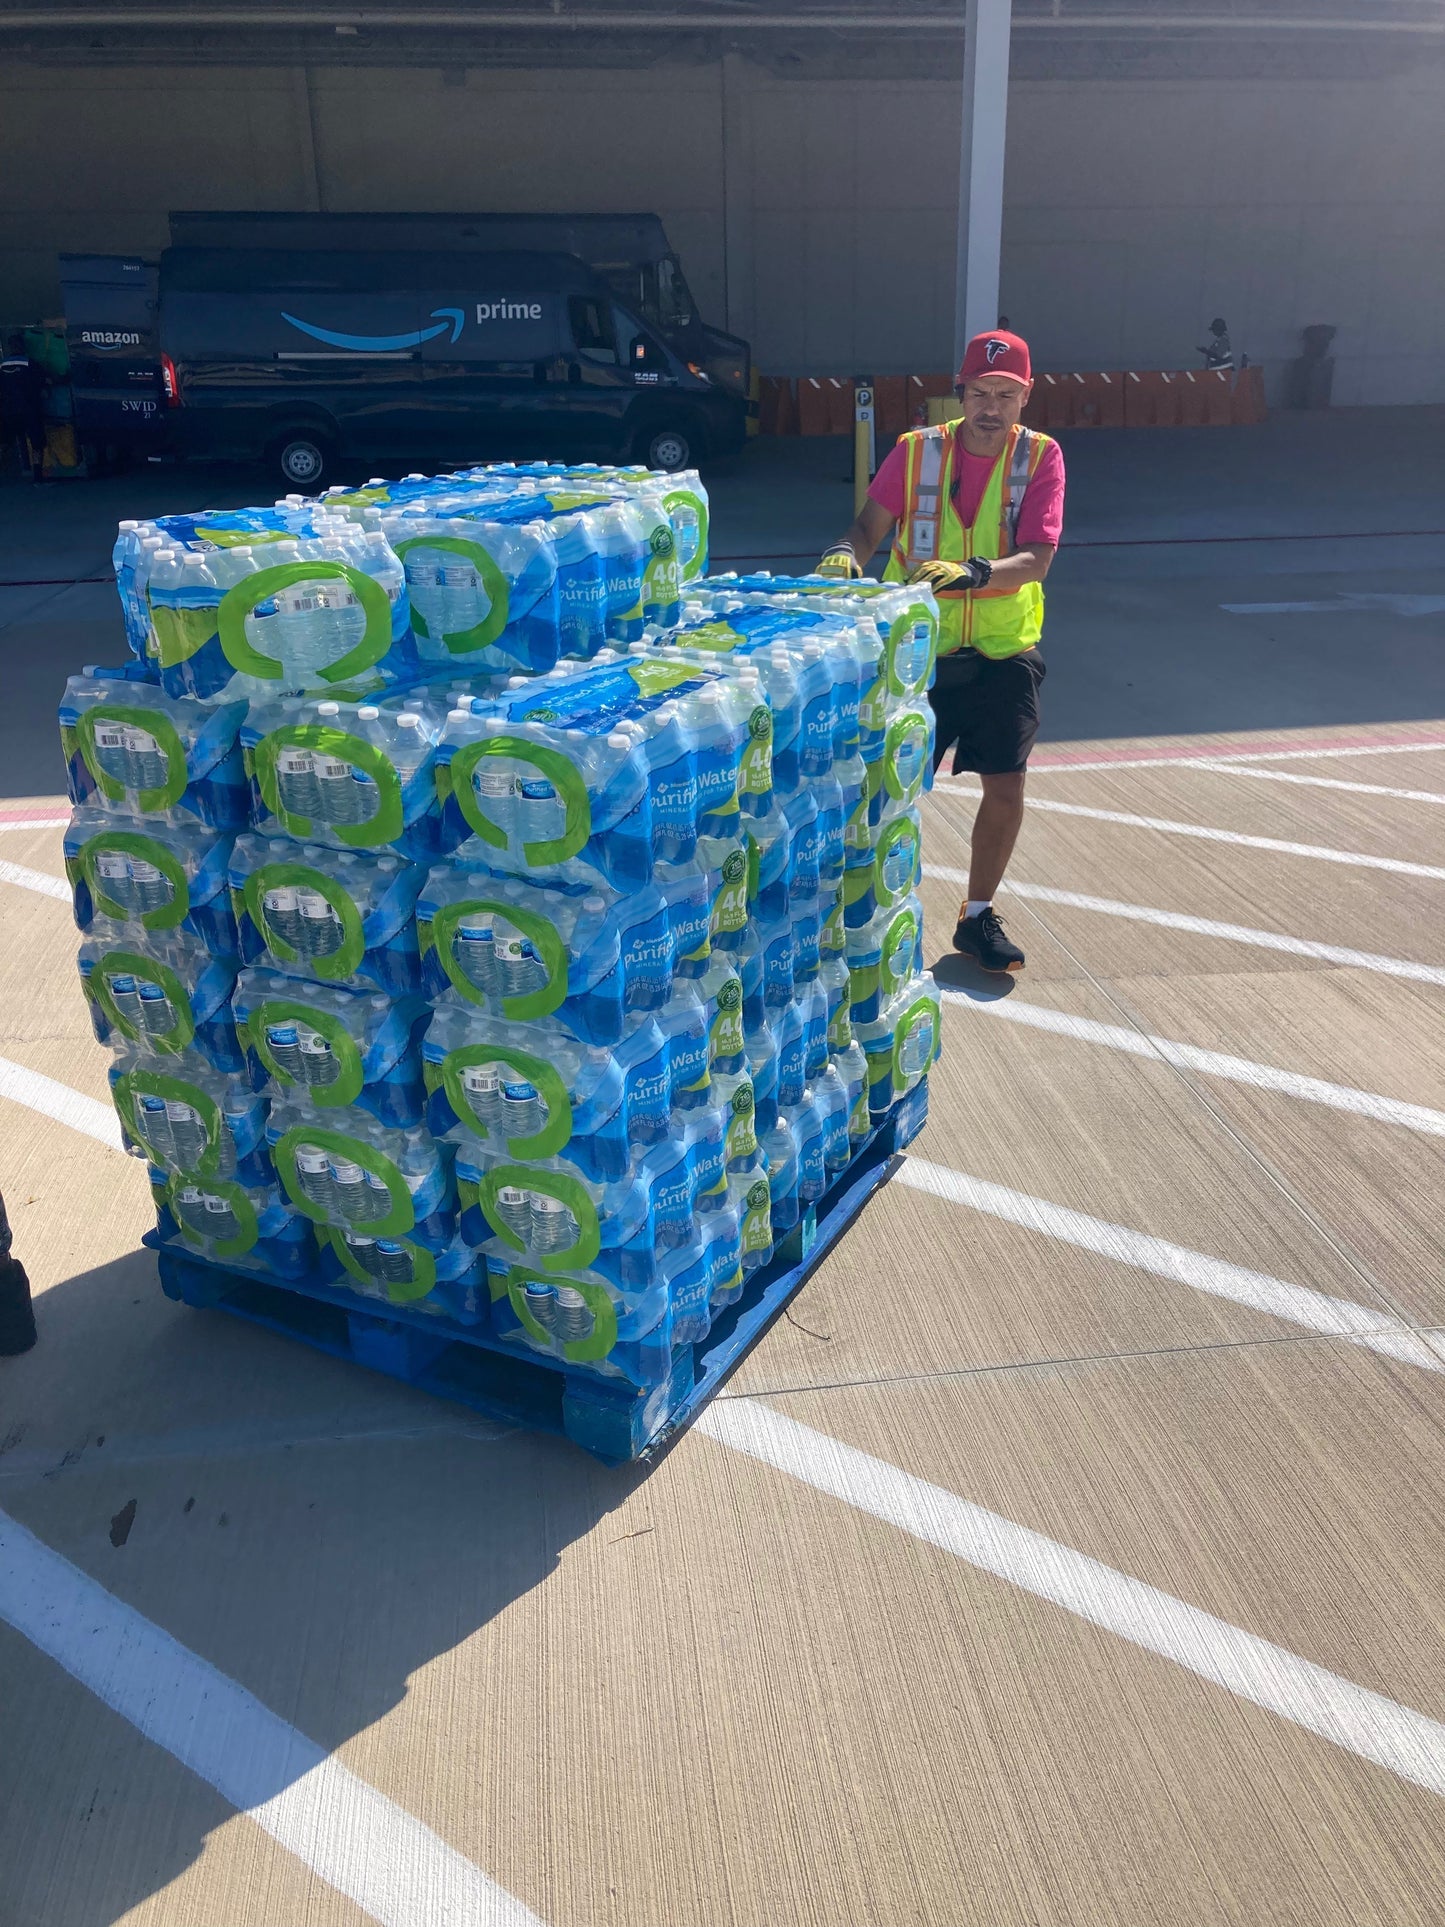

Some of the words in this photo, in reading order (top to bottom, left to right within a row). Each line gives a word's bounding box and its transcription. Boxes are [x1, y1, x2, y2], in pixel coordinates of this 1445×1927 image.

[475, 298, 542, 324] prime
[81, 331, 140, 344] amazon
[121, 400, 157, 412] SWID
[606, 576, 641, 593] Wate
[653, 561, 677, 585] 40
[750, 743, 772, 772] 40
[697, 768, 737, 789] Wate
[721, 886, 746, 911] 40
[674, 917, 709, 938] Wate
[719, 1012, 742, 1037] 40
[672, 1047, 707, 1070] Wate
[733, 1114, 755, 1138] 40
[694, 1153, 724, 1177] Wate
[748, 1210, 770, 1234] 40
[711, 1250, 739, 1274] Wate
